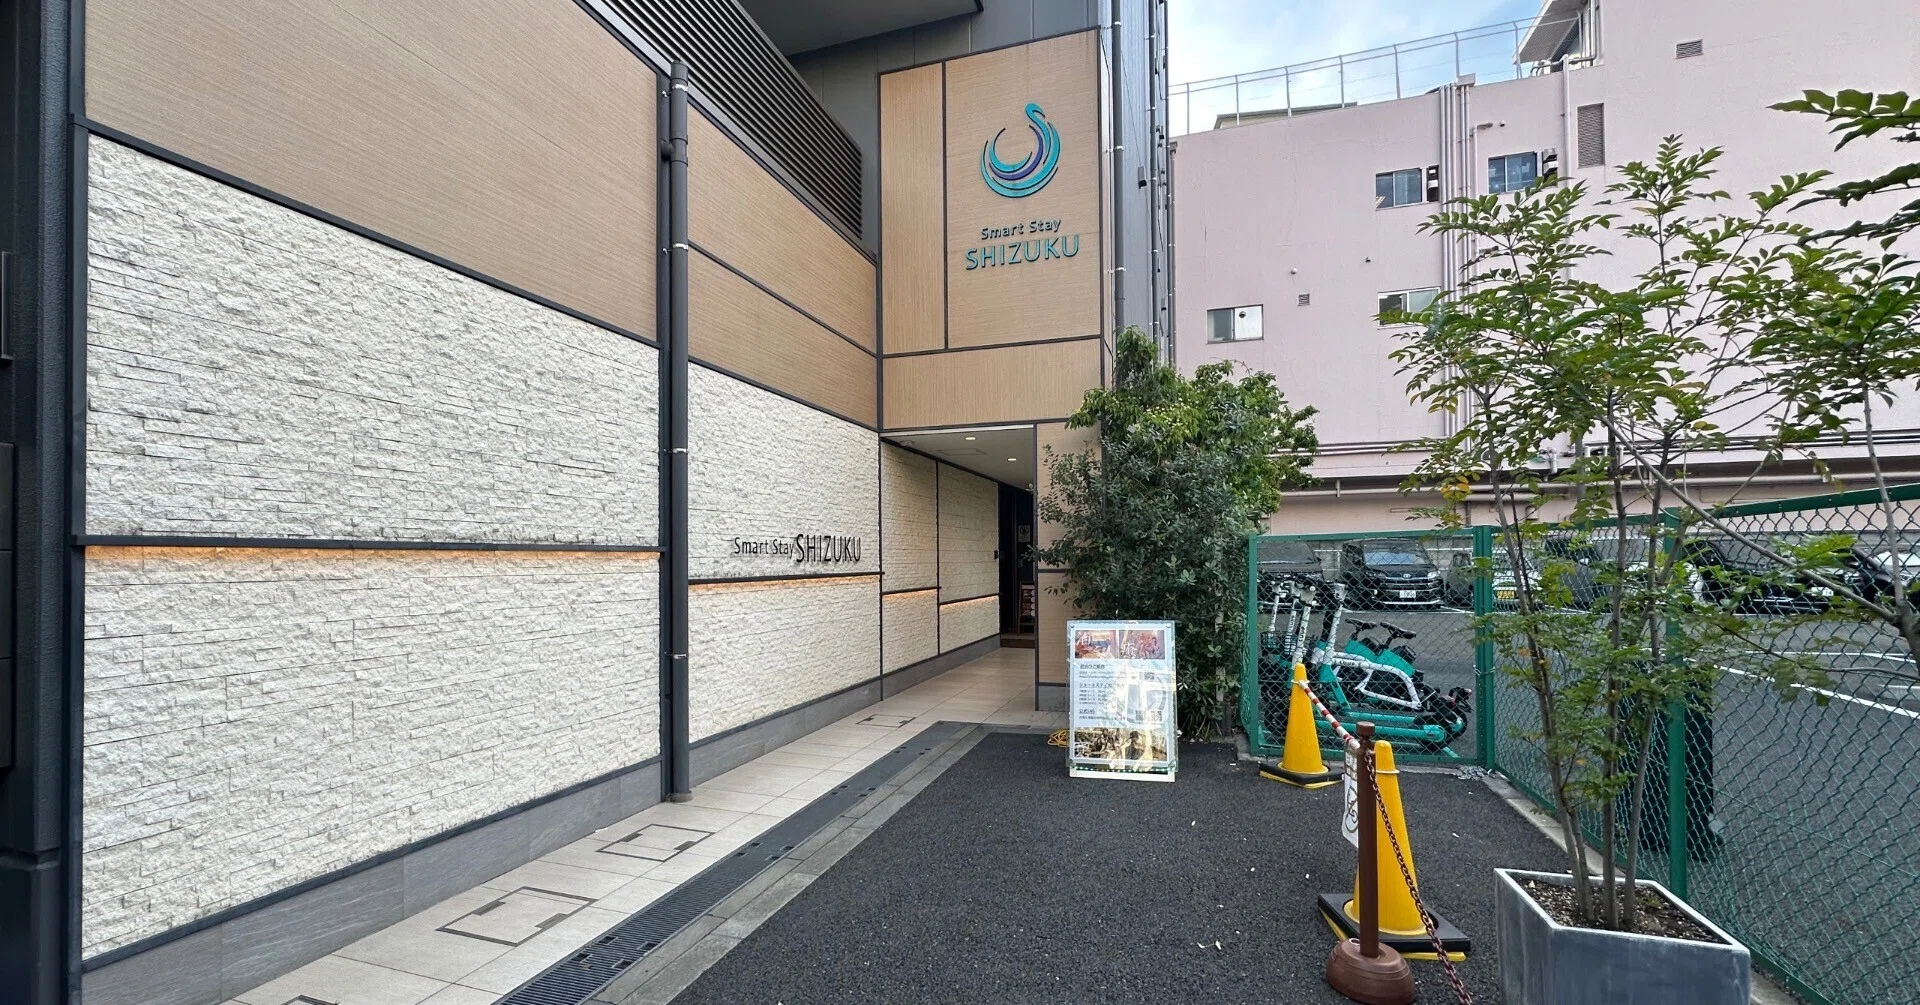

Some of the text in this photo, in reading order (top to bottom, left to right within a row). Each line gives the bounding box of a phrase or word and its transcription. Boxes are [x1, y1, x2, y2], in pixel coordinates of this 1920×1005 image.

[981, 218, 1062, 240] Smart Stay
[966, 234, 1080, 270] SHIZUKU
[734, 533, 862, 563] Smart Stay SHIZUKU
